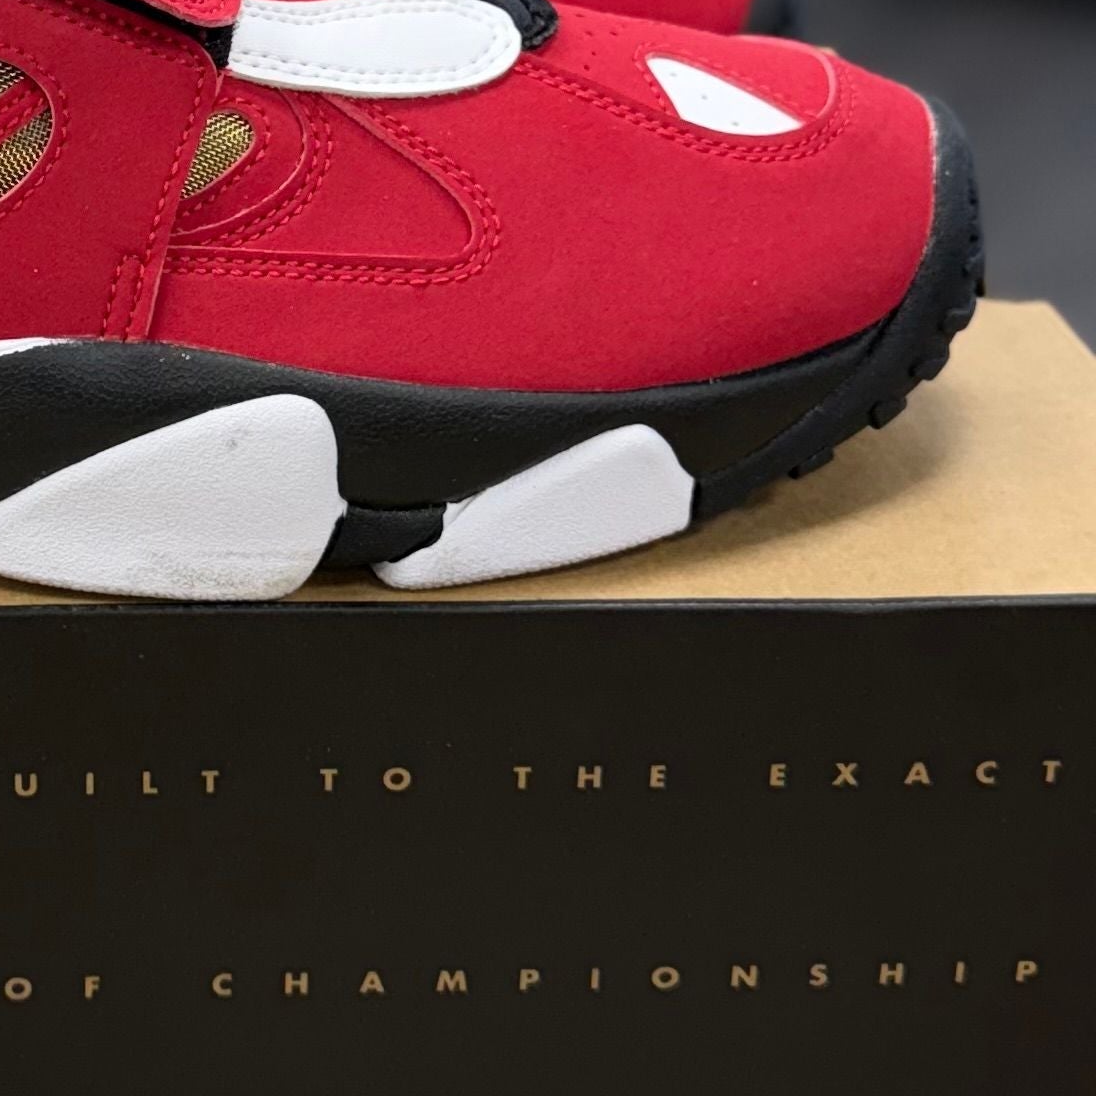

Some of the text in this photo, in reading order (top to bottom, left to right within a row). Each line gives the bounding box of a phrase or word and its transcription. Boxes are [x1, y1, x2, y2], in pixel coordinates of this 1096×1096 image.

[319, 767, 413, 793] TO
[512, 763, 667, 791] THE
[768, 759, 1063, 788] EXACT
[3, 974, 101, 1002] OF
[211, 959, 1039, 997] CHAMPIONSHIP
